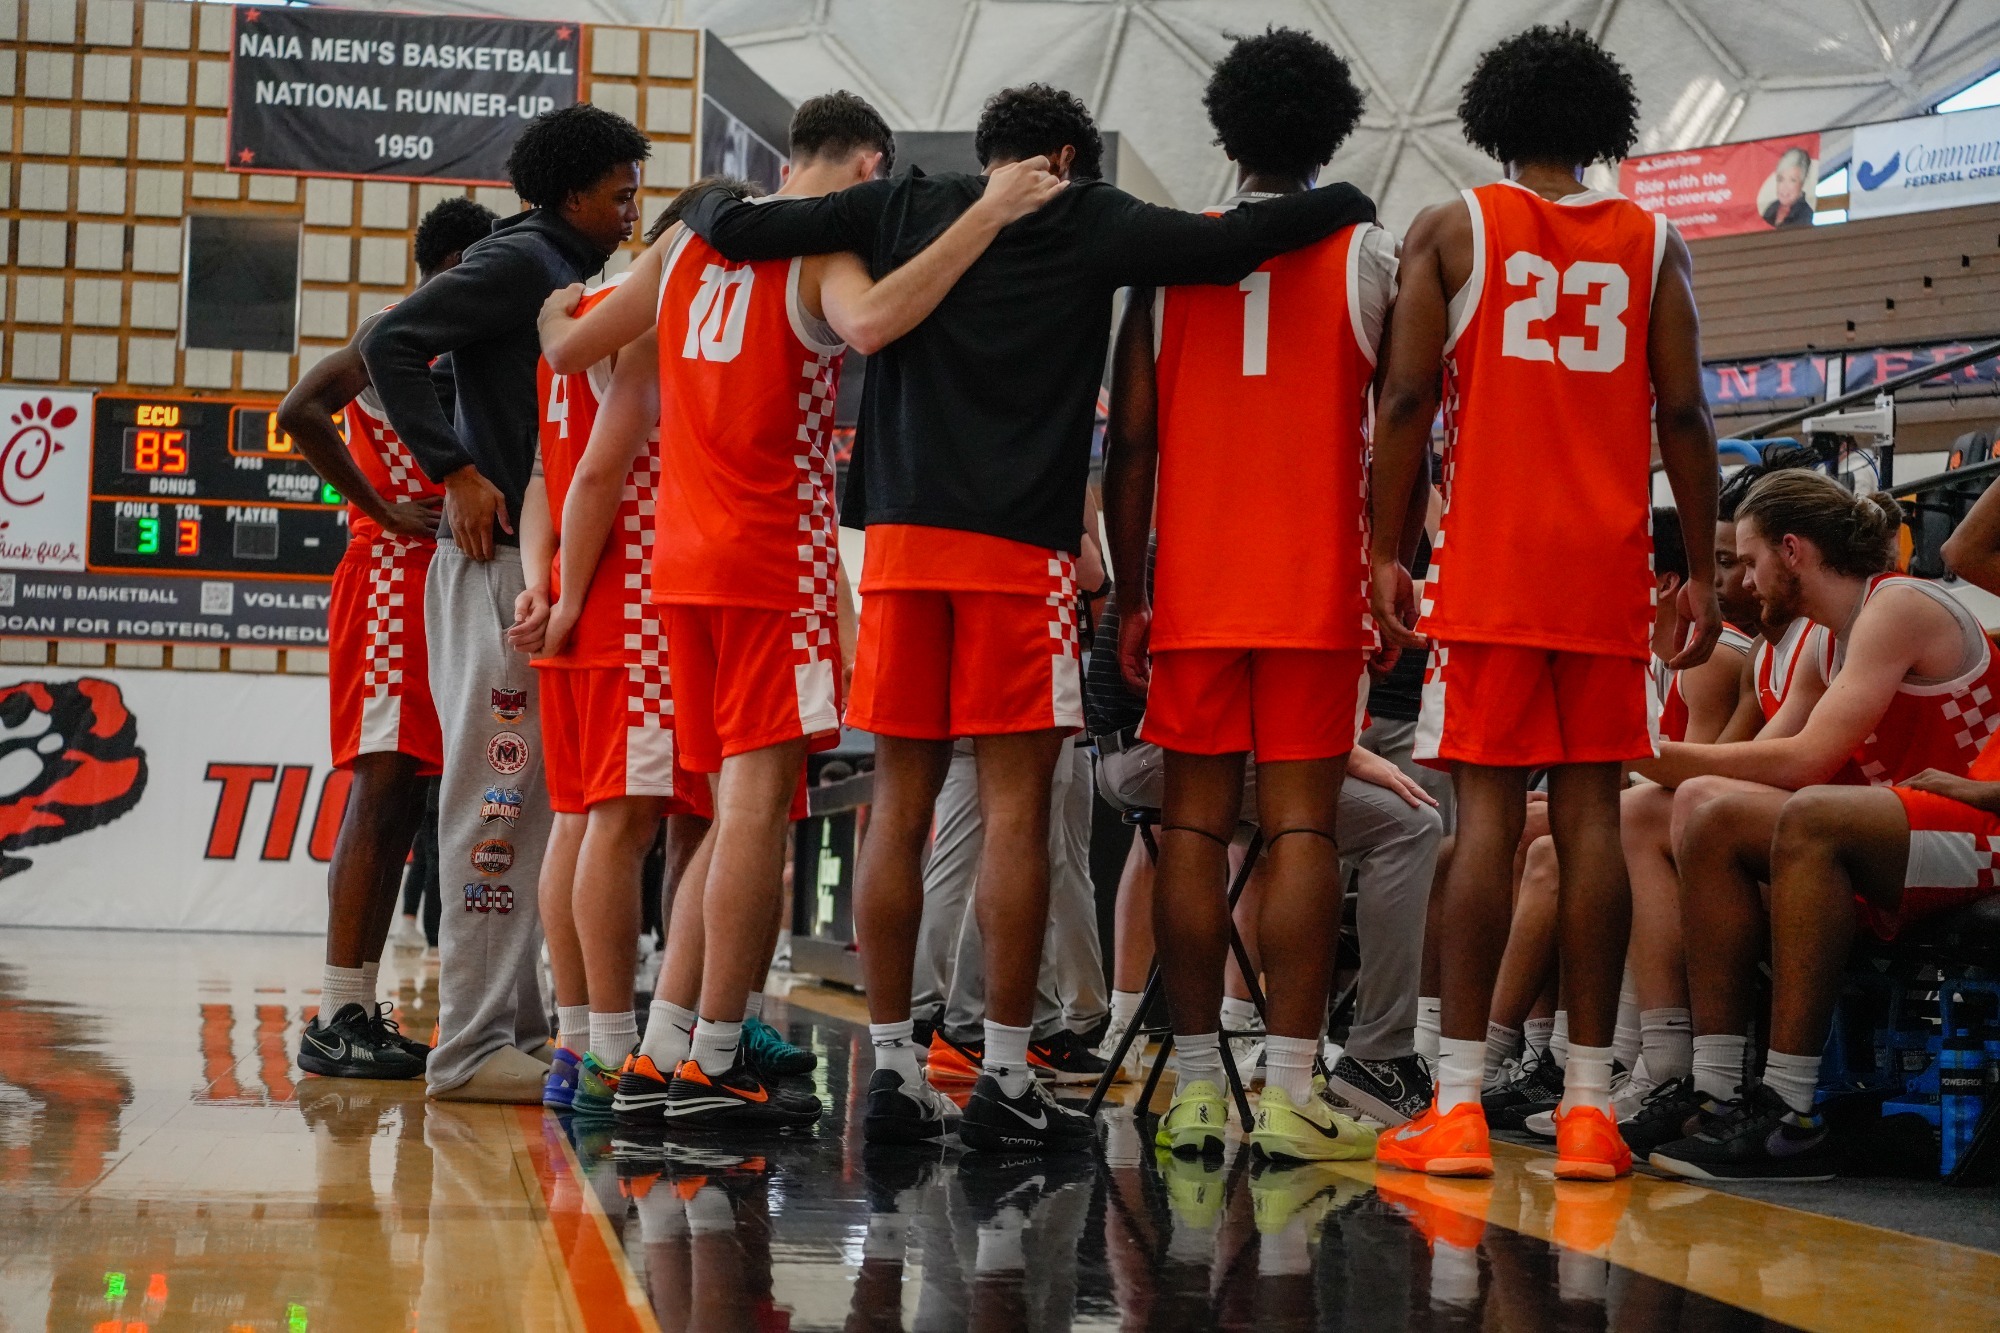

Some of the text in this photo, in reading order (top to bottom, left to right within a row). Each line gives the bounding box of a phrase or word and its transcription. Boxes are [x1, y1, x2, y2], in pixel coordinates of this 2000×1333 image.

[239, 33, 574, 76] NAIA MEN'S BASKETBALL
[255, 80, 554, 119] NATIONAL RUNNER-UP
[374, 133, 434, 160] 1950
[1635, 172, 1727, 195] Ride with the
[1904, 170, 1964, 188] FEDERAL
[682, 263, 755, 363] 10
[1239, 271, 1271, 377] 1
[1502, 250, 1630, 374] 23
[137, 405, 179, 428] ECU
[547, 374, 569, 439] 4
[135, 430, 188, 474] 85
[150, 477, 197, 495] BONUS
[267, 474, 320, 492] PERIOD
[115, 502, 279, 524] FOULS TOL PLAYER
[137, 518, 199, 555] 3 3
[22, 583, 179, 604] MEN'S BASKETBALL
[0, 614, 56, 632] SCAN
[63, 618, 110, 634] FOR
[117, 619, 231, 641] ROSTERS,
[497, 745, 517, 763] M
[480, 802, 521, 819] HOMME
[463, 882, 514, 915] 100
